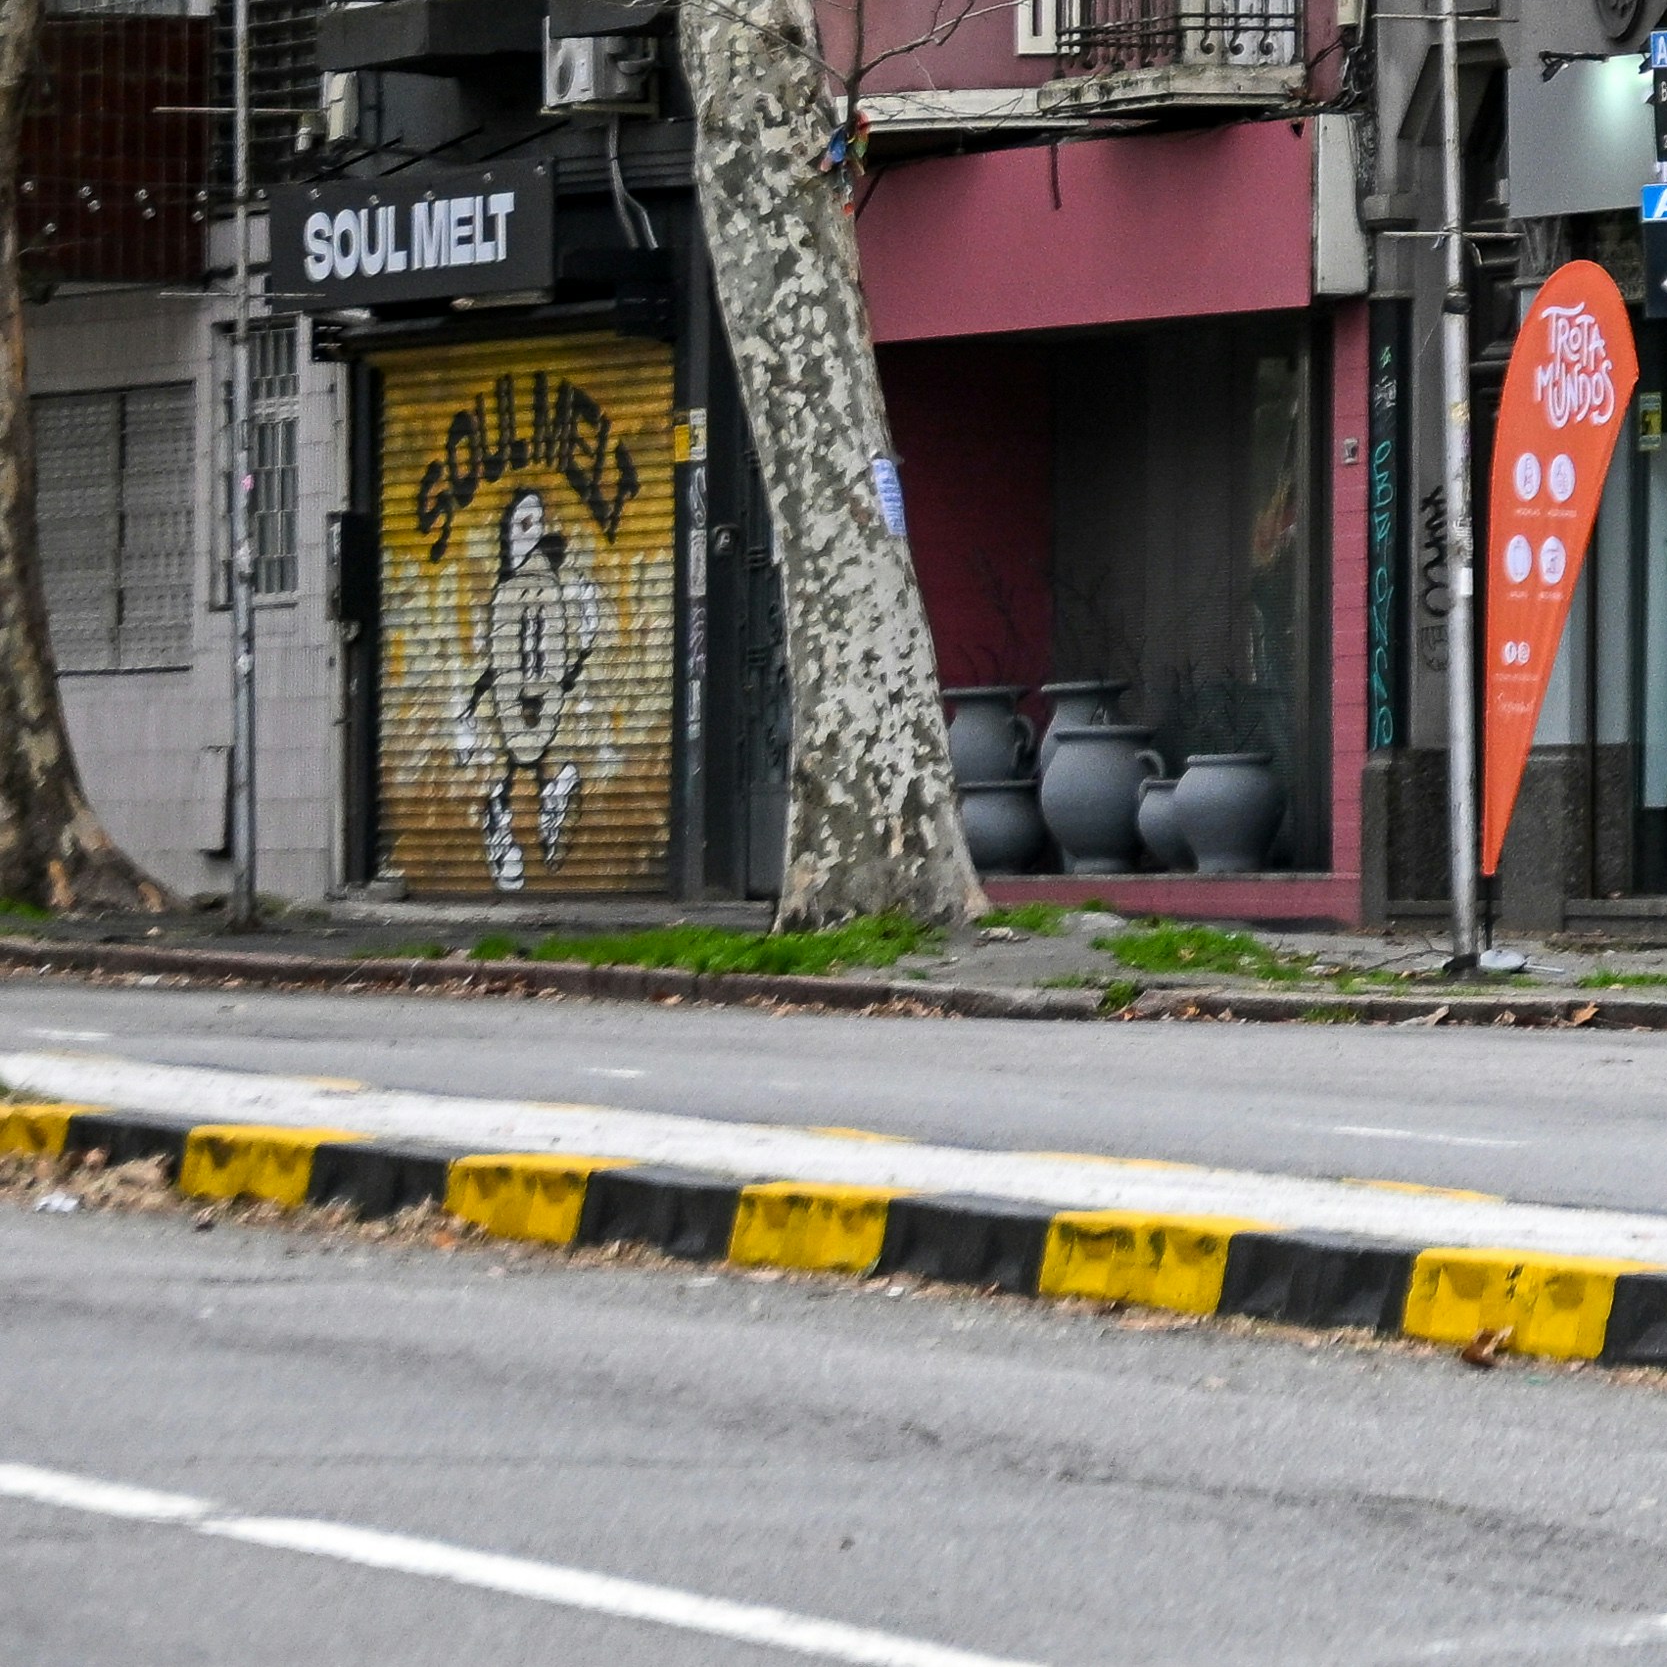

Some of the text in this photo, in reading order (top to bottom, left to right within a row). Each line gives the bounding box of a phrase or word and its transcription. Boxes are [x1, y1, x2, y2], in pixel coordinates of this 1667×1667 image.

[304, 191, 515, 283] SOUL MELT
[1541, 301, 1606, 379] TROTA
[1536, 360, 1615, 428] MUNDOS
